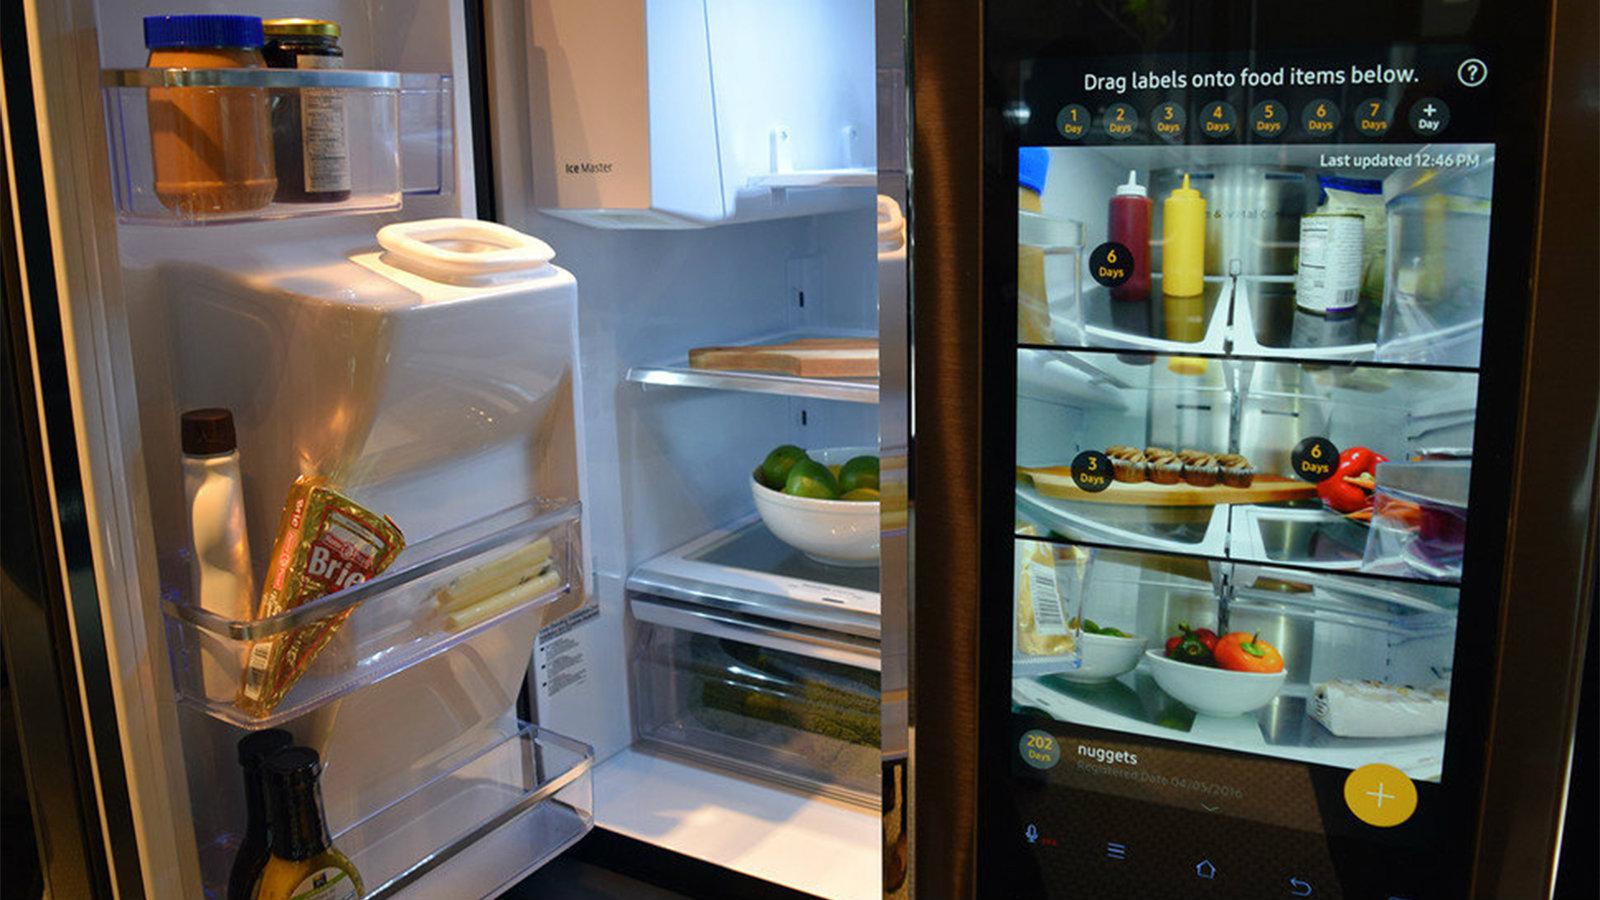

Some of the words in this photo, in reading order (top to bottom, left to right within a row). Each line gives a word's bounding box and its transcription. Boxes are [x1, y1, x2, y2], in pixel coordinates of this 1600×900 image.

[1084, 73, 1126, 94] Drag
[1132, 70, 1187, 89] labels
[1192, 70, 1235, 88] onto
[1240, 67, 1284, 86] food
[1290, 67, 1346, 85] items
[1351, 64, 1419, 83] below.
[1070, 109, 1078, 122] 1
[1116, 108, 1125, 121] 2
[1164, 106, 1174, 120] 3
[1212, 106, 1223, 119] 4
[1264, 104, 1274, 118] 5
[1316, 104, 1327, 118] 6
[1370, 103, 1380, 116] 7
[1064, 123, 1083, 135] Day
[1109, 123, 1132, 134] Days
[1157, 122, 1180, 133] Days
[1206, 121, 1230, 132] Days
[1256, 121, 1281, 132] Days
[1308, 120, 1333, 131] Days
[1361, 119, 1388, 130] Days
[1418, 119, 1440, 131] Day
[581, 162, 613, 174] Master
[1320, 153, 1350, 168] Last
[1353, 153, 1412, 170] updated
[1414, 153, 1454, 168] 12:46
[1456, 153, 1480, 168] PM
[1107, 249, 1118, 263] 6
[1099, 266, 1124, 279] Days
[1311, 444, 1322, 459] 6
[1087, 456, 1098, 471] 3
[1302, 460, 1329, 474] Days
[1080, 472, 1104, 485] Days
[308, 546, 367, 587] Brie
[1027, 734, 1053, 751] 202
[1028, 749, 1052, 762] Days
[1077, 744, 1138, 765] nuggets
[1140, 772, 1168, 786] Date
